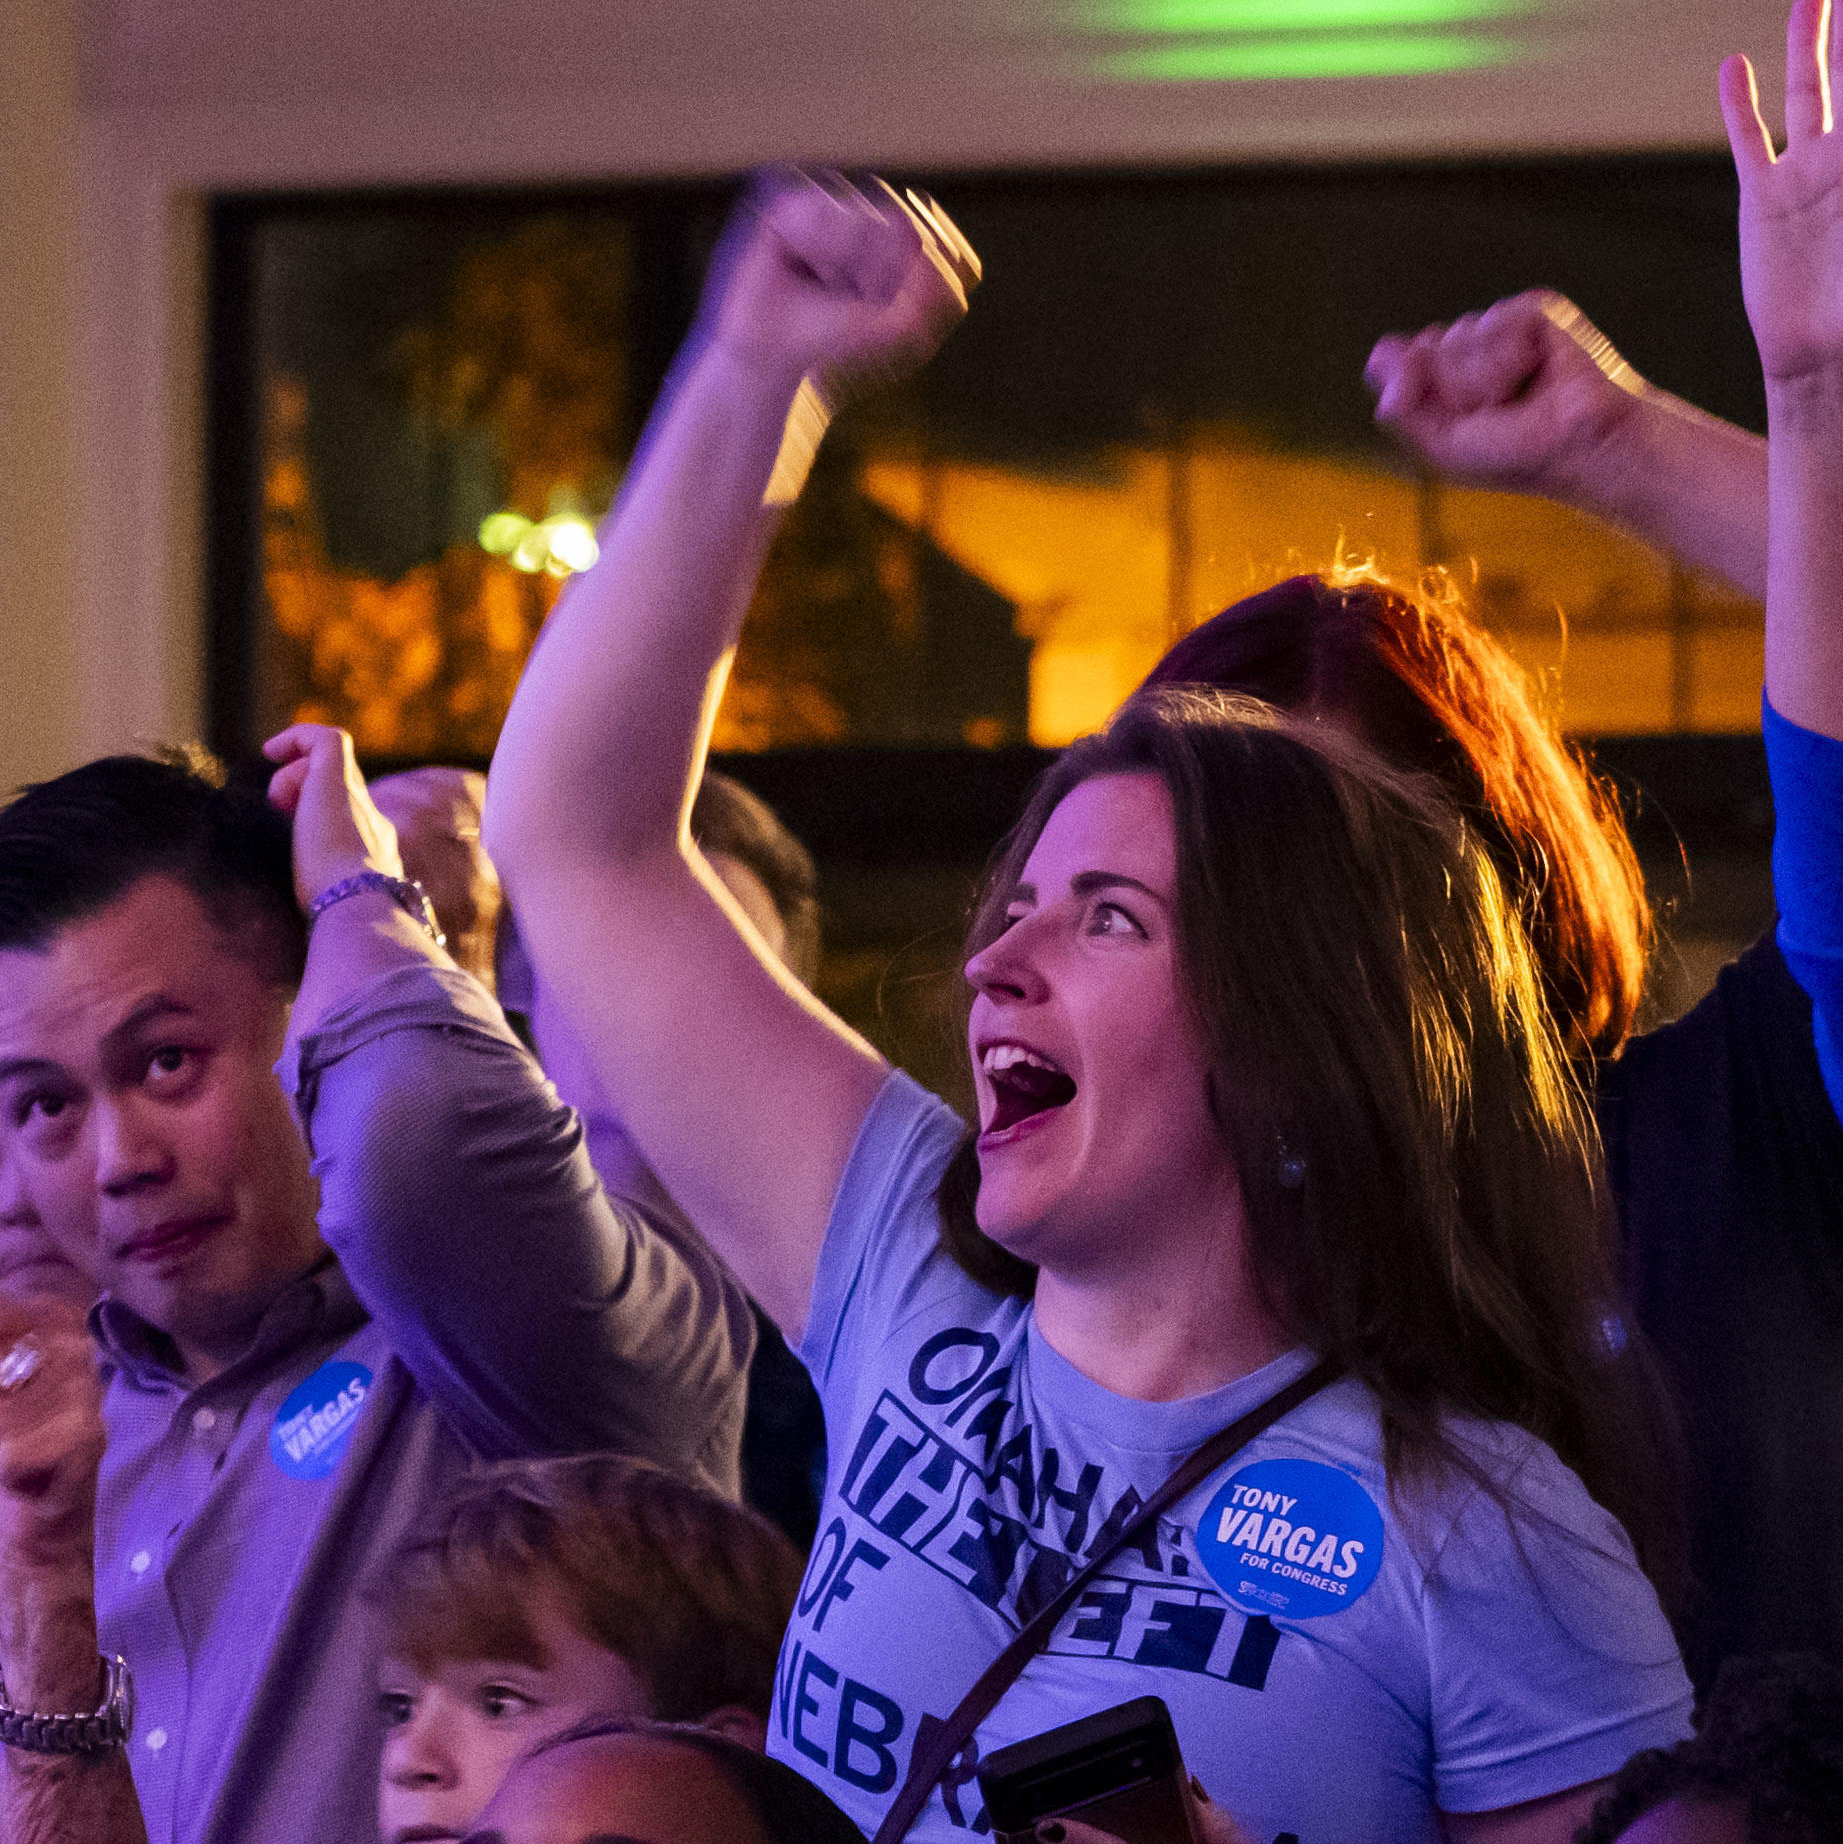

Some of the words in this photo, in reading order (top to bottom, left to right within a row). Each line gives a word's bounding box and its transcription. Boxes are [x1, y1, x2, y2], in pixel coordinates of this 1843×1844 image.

[843, 1395, 983, 1586] THE
[1230, 1484, 1298, 1516] TONY
[798, 1515, 891, 1632] OF
[1215, 1506, 1365, 1579] VARGAS
[1240, 1552, 1270, 1571] FOR
[1271, 1561, 1349, 1597] CONGRESS
